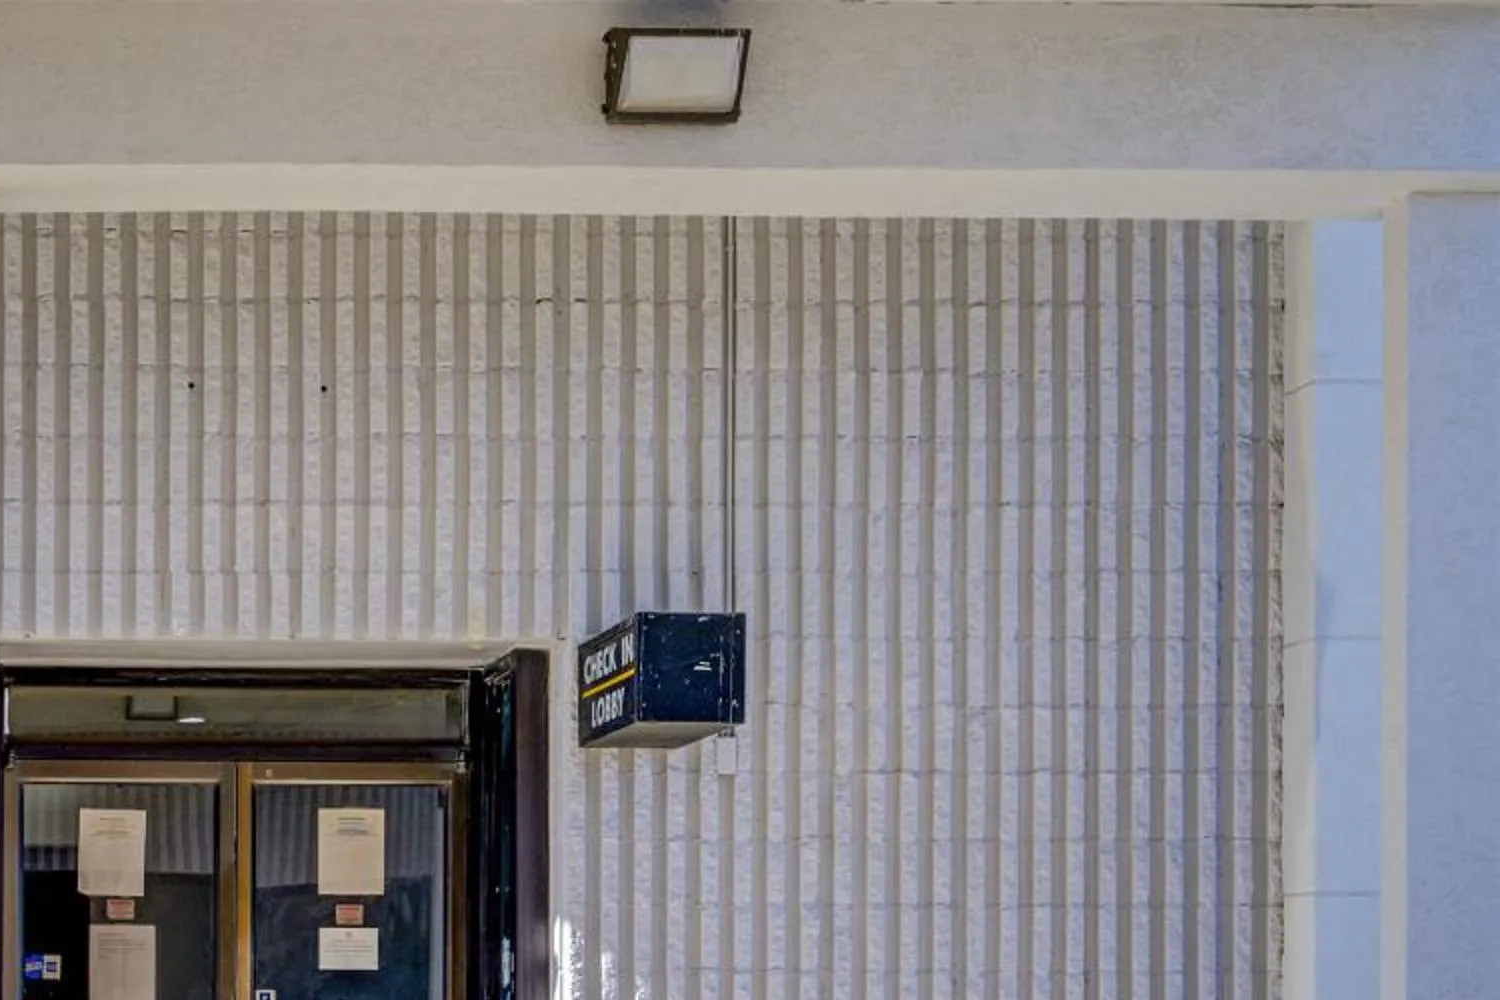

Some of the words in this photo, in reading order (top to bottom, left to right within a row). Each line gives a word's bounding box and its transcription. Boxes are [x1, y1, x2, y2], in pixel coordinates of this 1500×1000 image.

[583, 642, 618, 685] CHECK
[621, 633, 634, 667] IN
[591, 686, 625, 729] LOBBY
